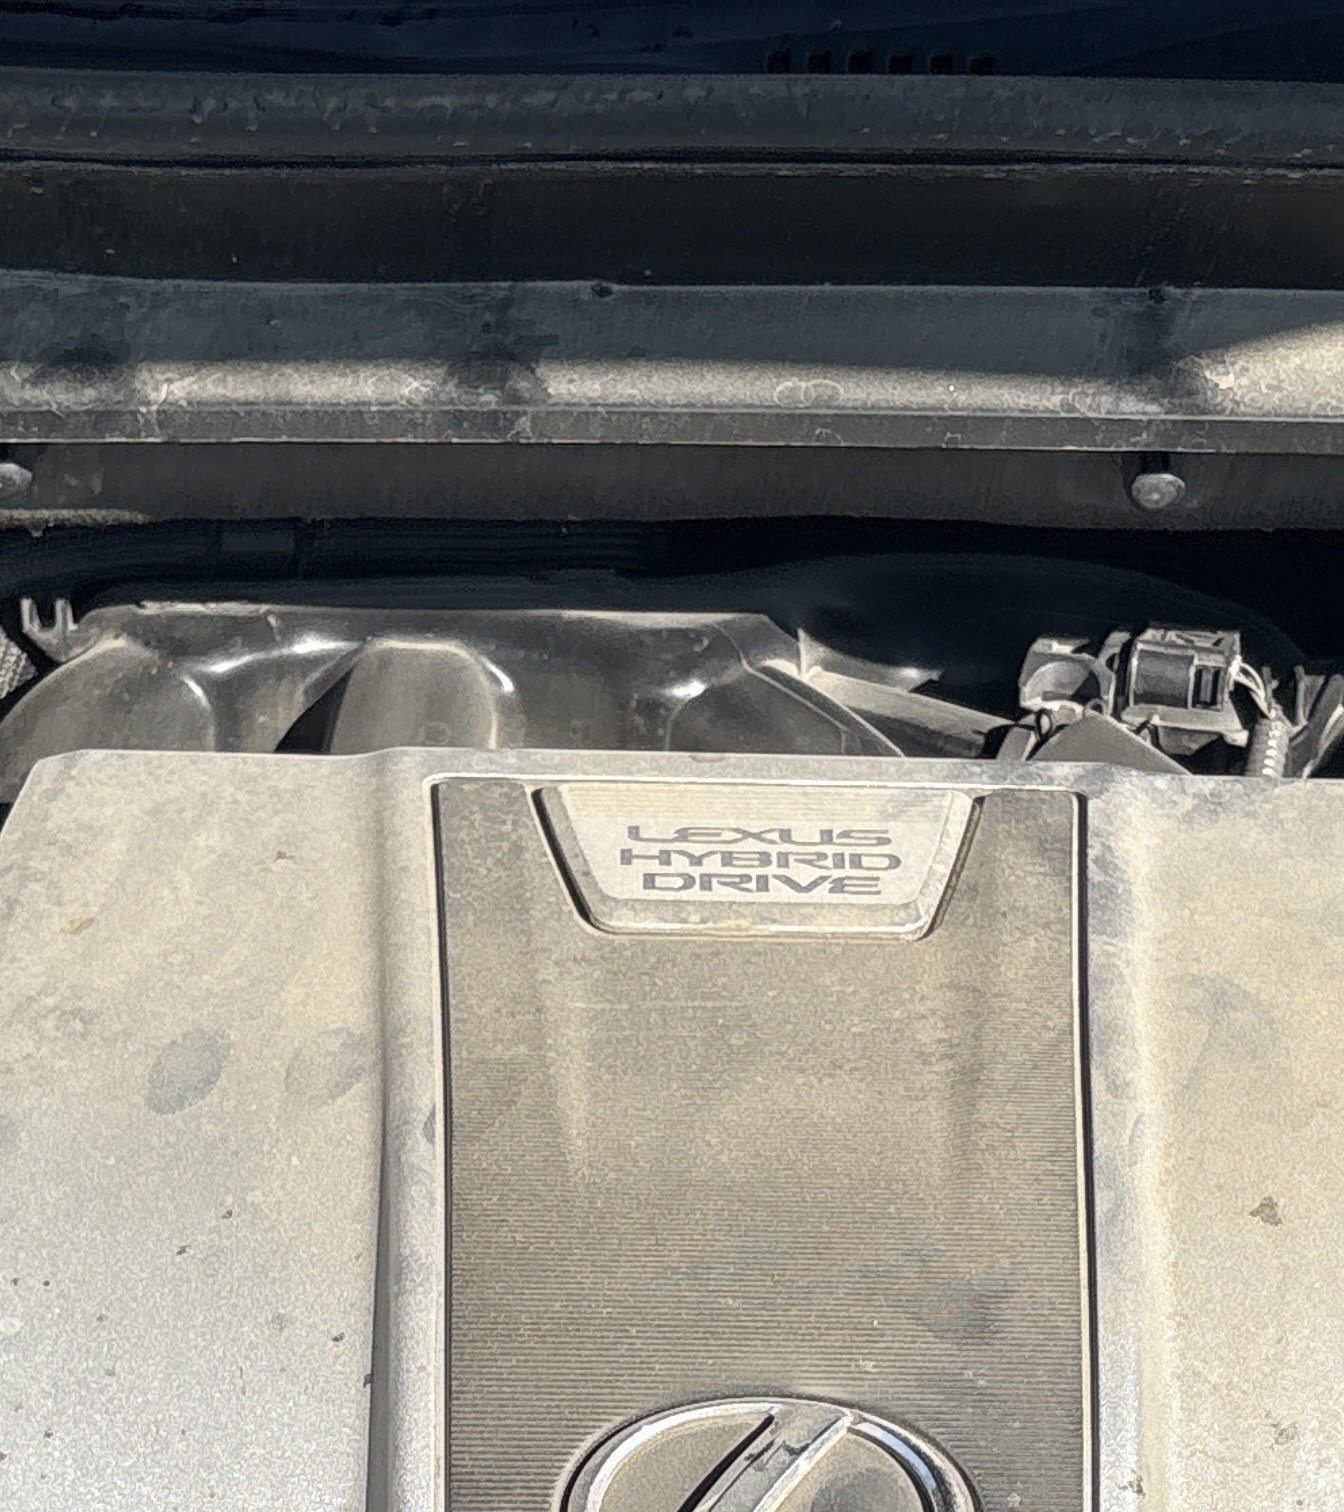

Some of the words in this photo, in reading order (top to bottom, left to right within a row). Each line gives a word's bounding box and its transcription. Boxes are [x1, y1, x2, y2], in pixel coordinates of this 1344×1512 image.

[626, 825, 893, 848] LEXUS
[619, 847, 903, 872] HYBRID
[641, 872, 882, 896] DRIVE
